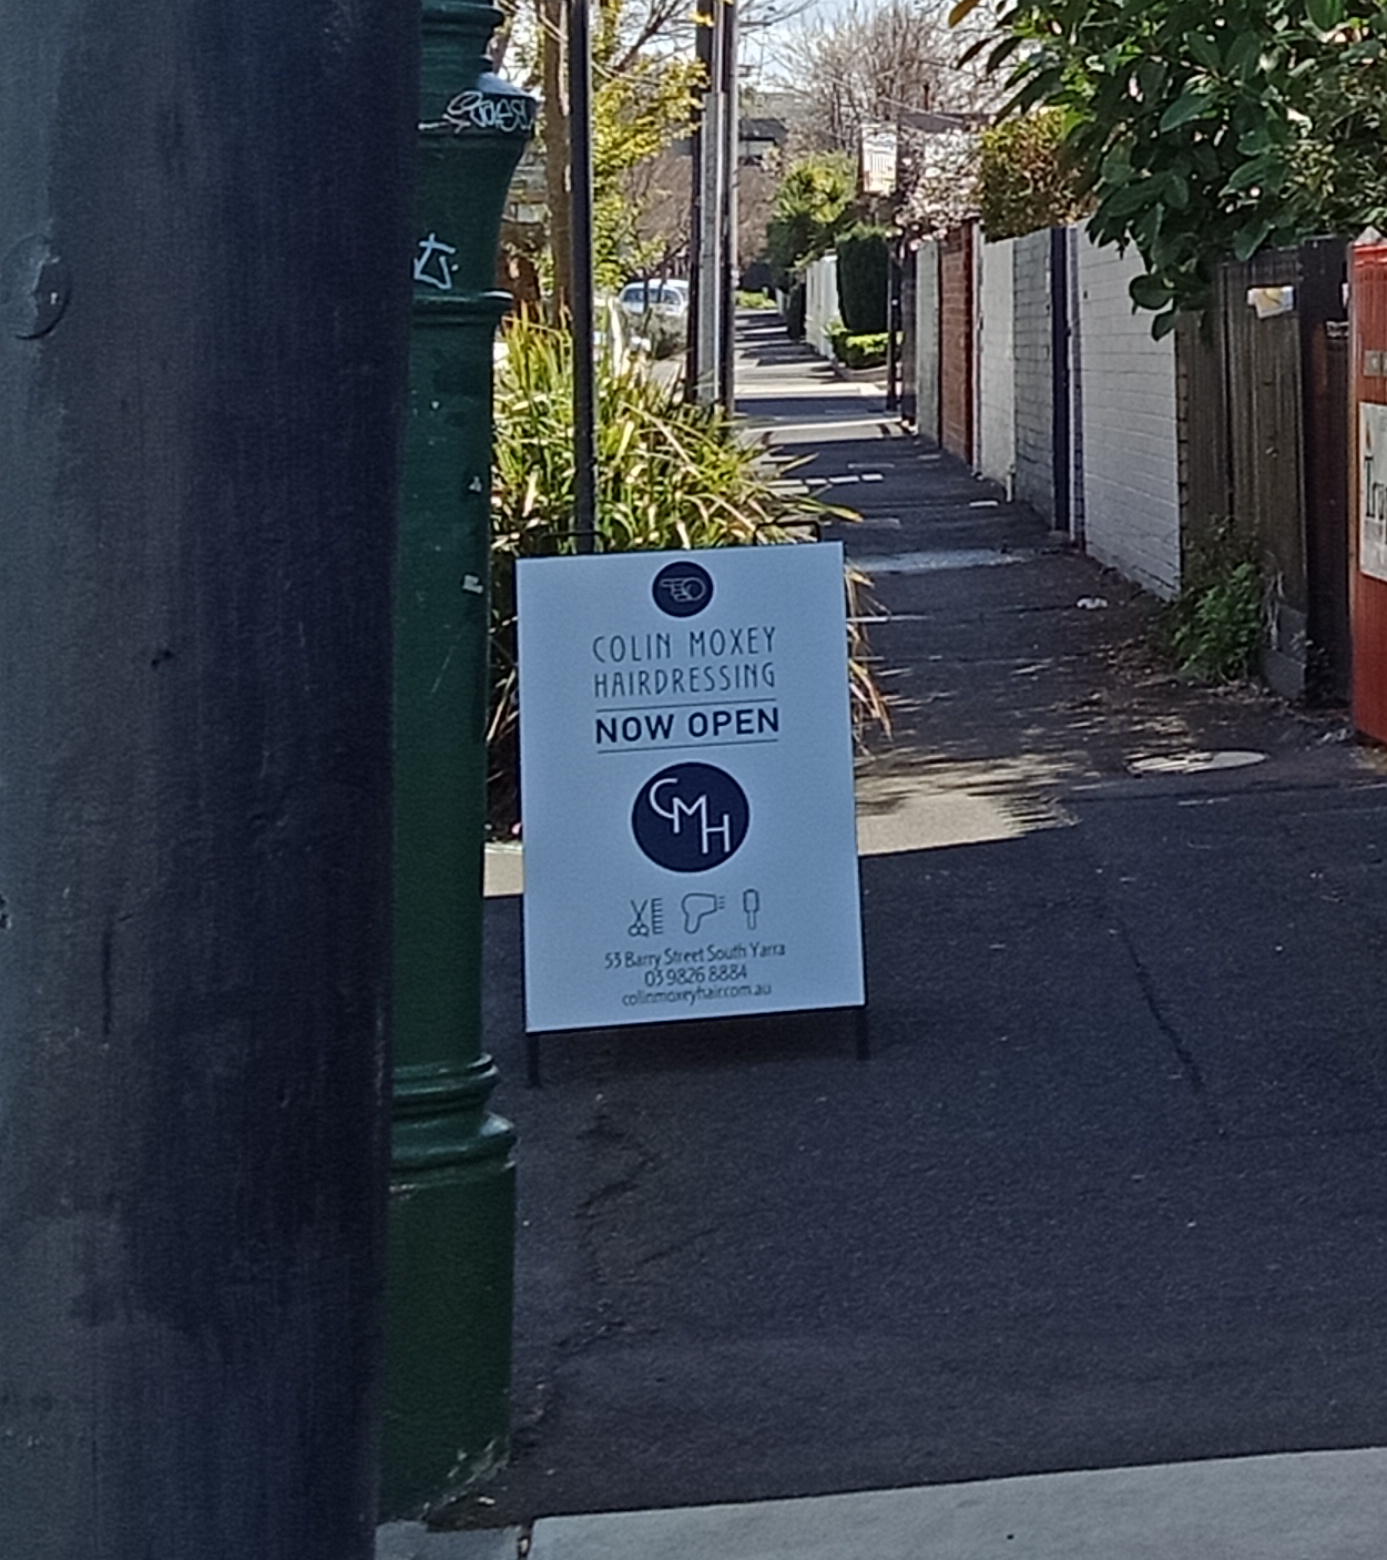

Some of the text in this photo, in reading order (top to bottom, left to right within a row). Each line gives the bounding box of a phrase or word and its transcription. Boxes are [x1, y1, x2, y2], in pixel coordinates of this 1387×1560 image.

[592, 626, 776, 663] COLIN MOXEY
[593, 662, 776, 698] HAIRDRESSING
[595, 707, 779, 744] NOW OPEN
[648, 777, 730, 855] CMH
[604, 941, 786, 969] 53 Barry Street South Yarra
[644, 970, 664, 987] 03
[666, 966, 706, 986] 9826
